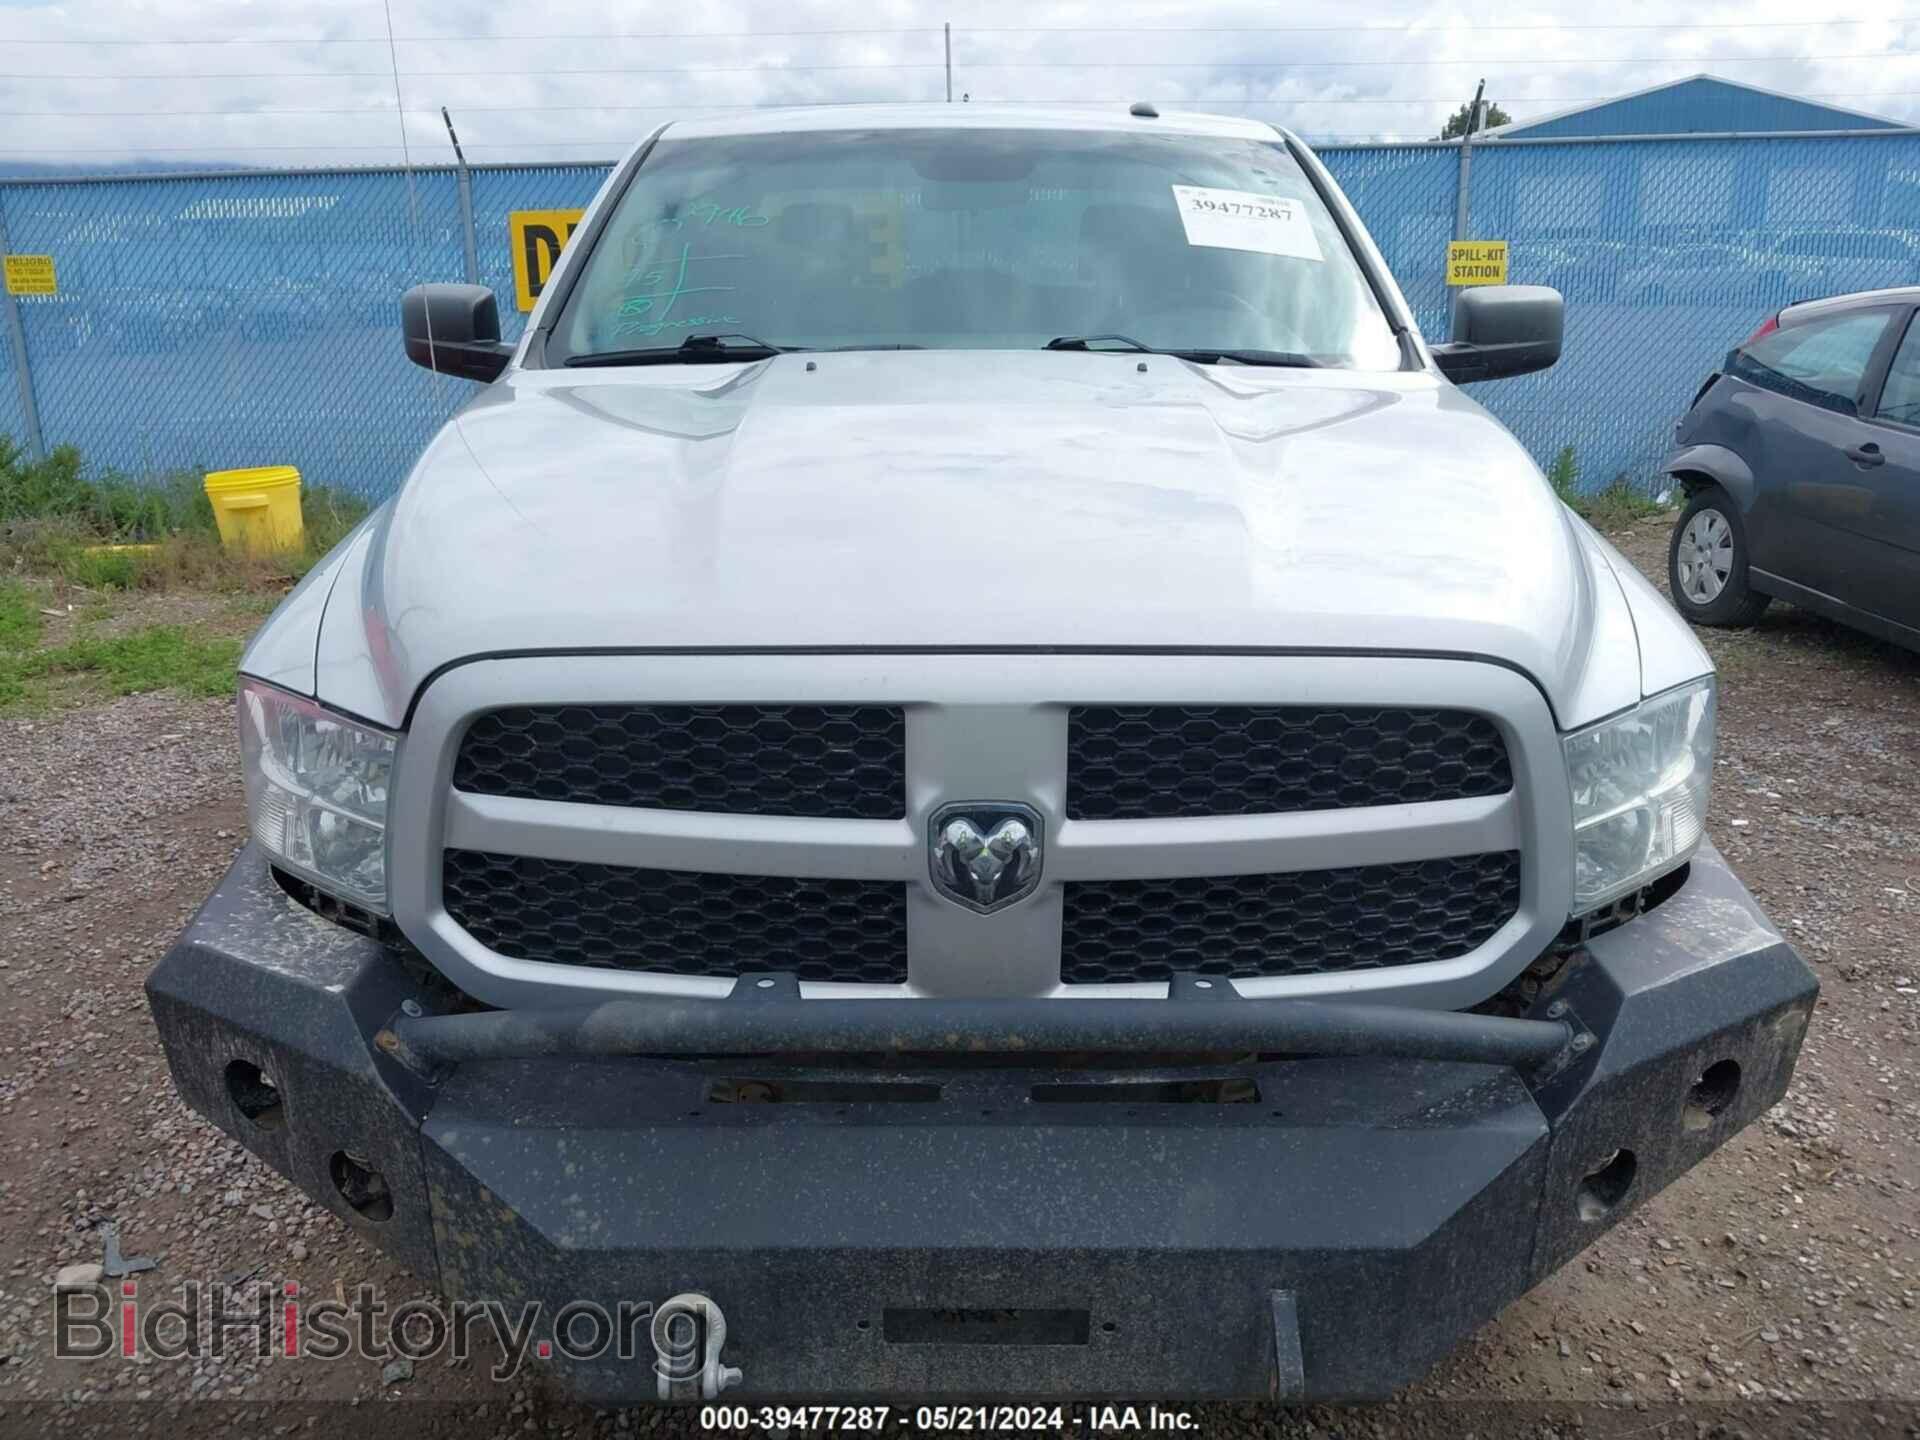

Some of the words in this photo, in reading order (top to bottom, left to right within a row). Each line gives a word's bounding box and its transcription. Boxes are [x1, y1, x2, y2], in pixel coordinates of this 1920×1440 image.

[1191, 199, 1292, 221] 39477287
[1451, 248, 1505, 261] SPILL-KIT
[1454, 265, 1500, 278] STATION
